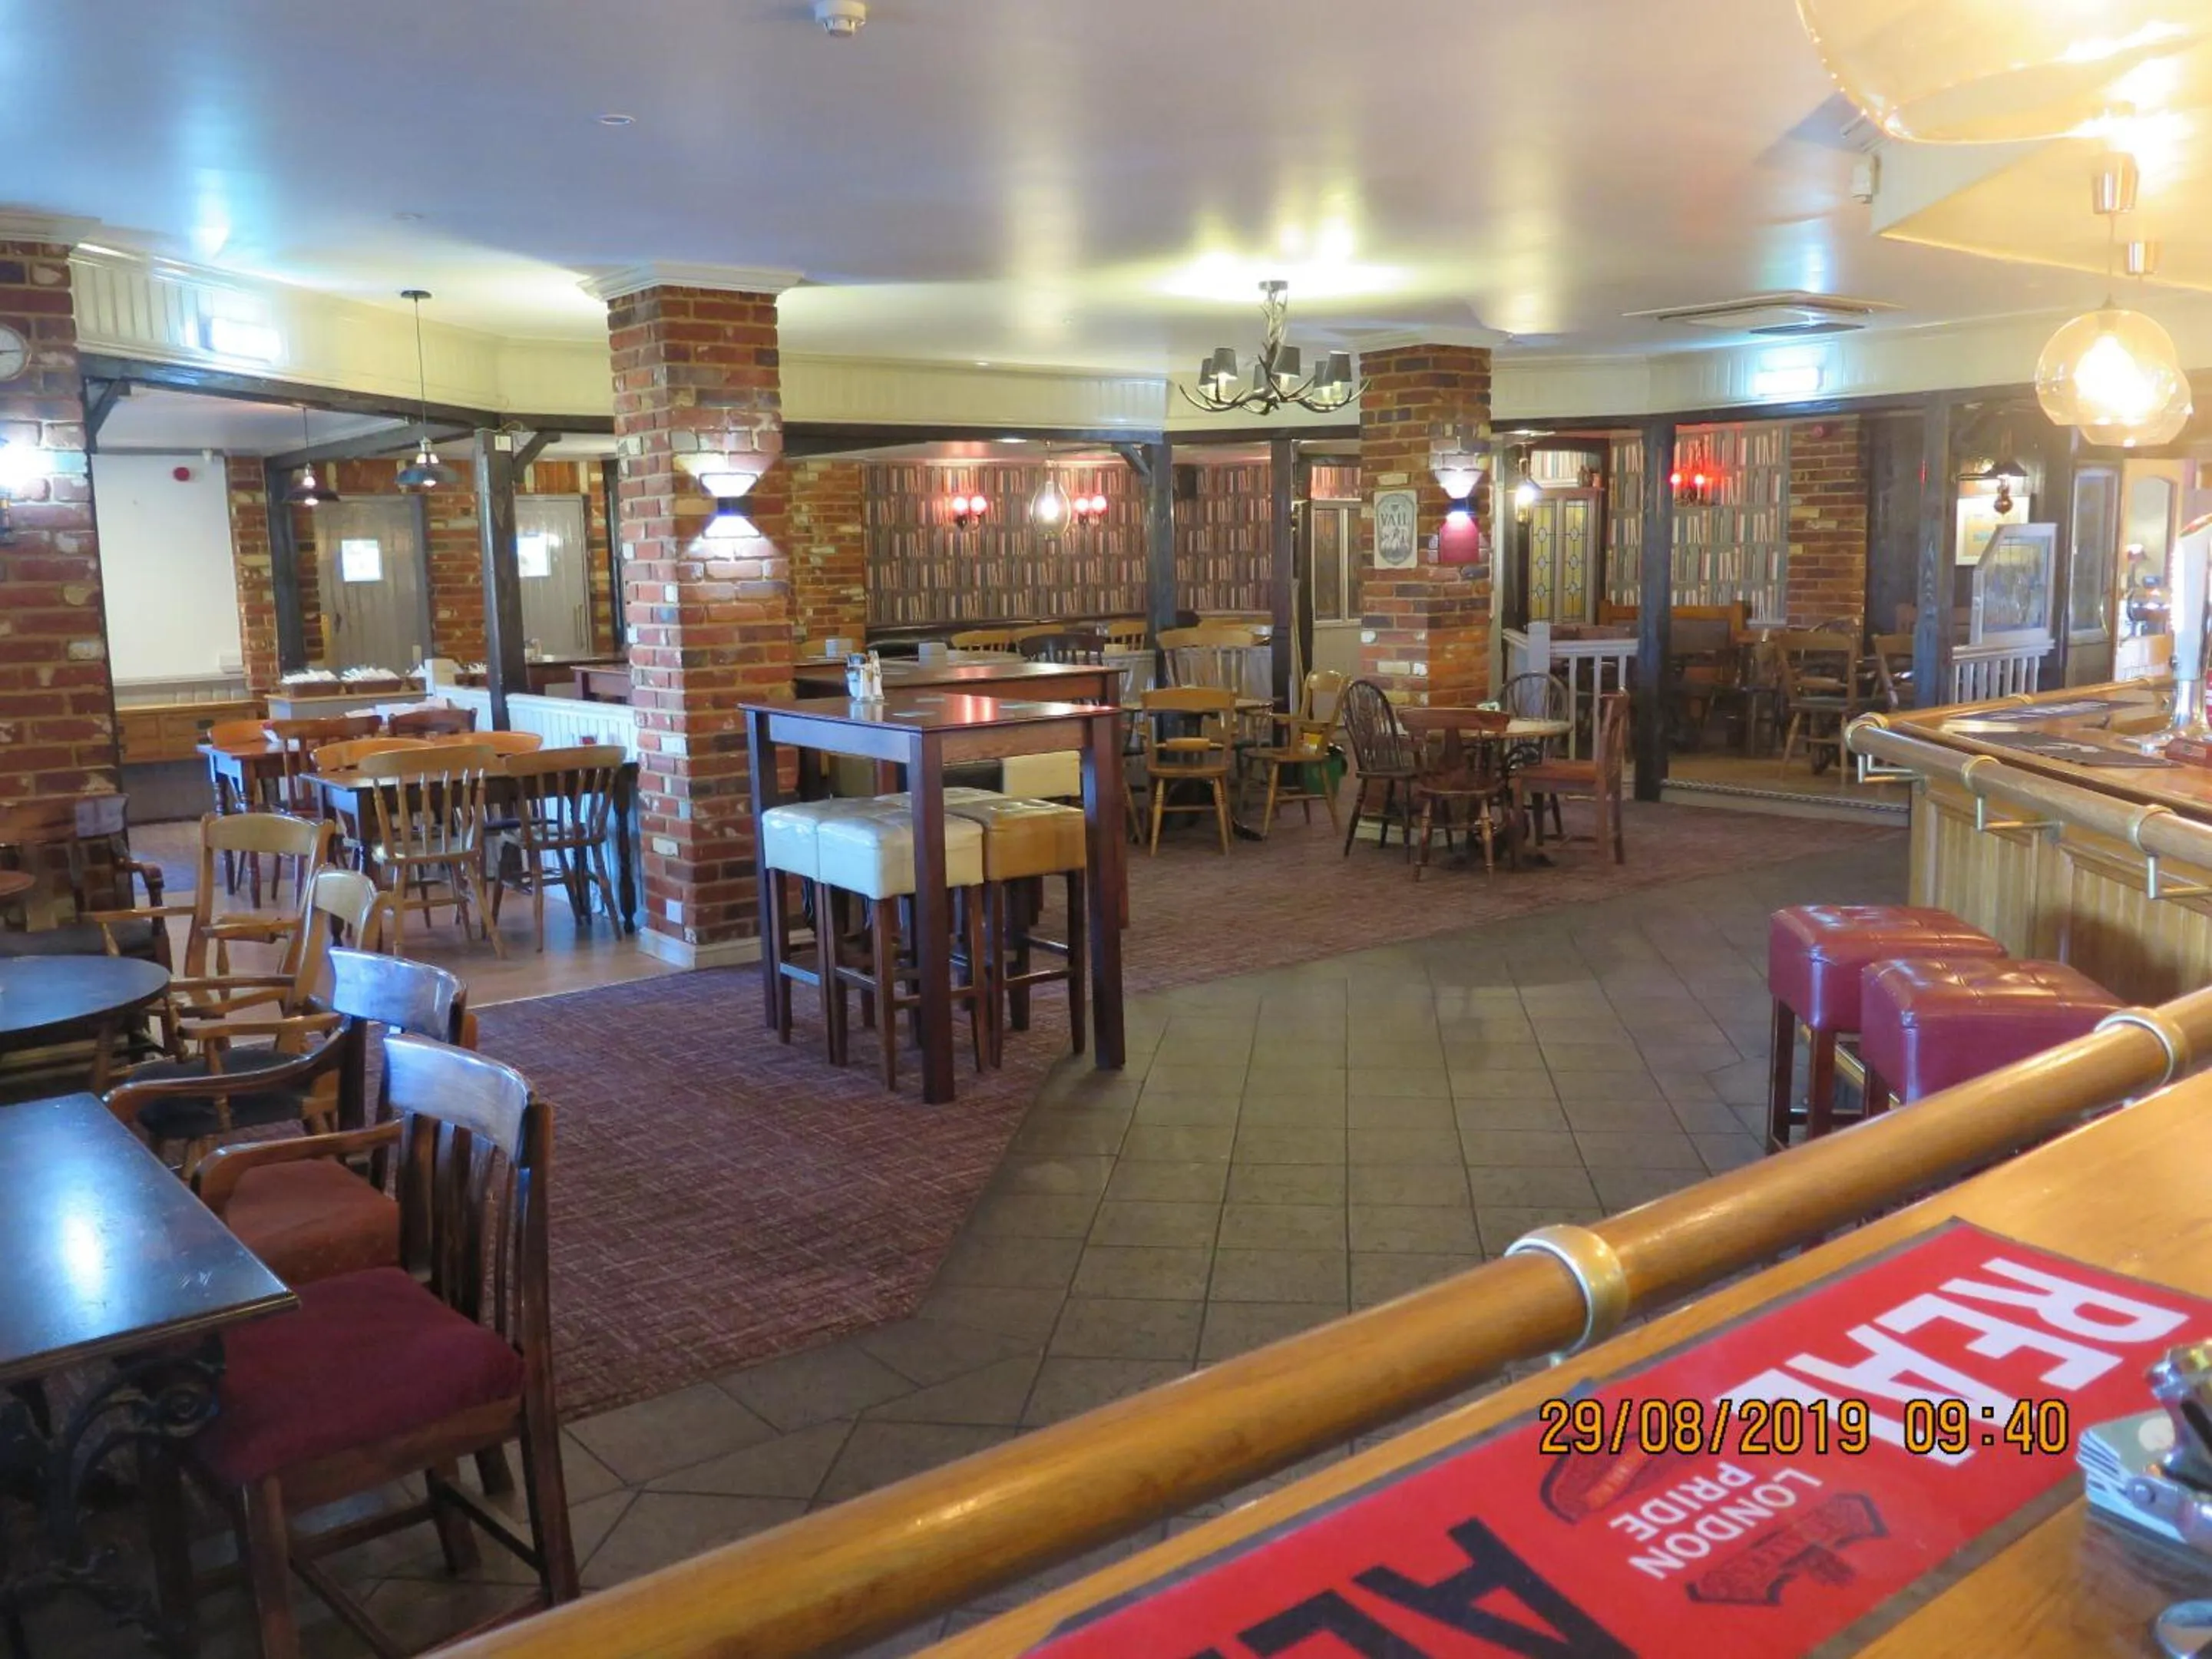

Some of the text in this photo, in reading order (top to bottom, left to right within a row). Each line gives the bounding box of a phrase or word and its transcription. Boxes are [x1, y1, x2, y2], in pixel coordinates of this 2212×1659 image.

[1711, 1257, 2191, 1467] REAL
[1609, 1462, 1756, 1542] PRIDE
[1628, 1467, 1823, 1581] LONDON
